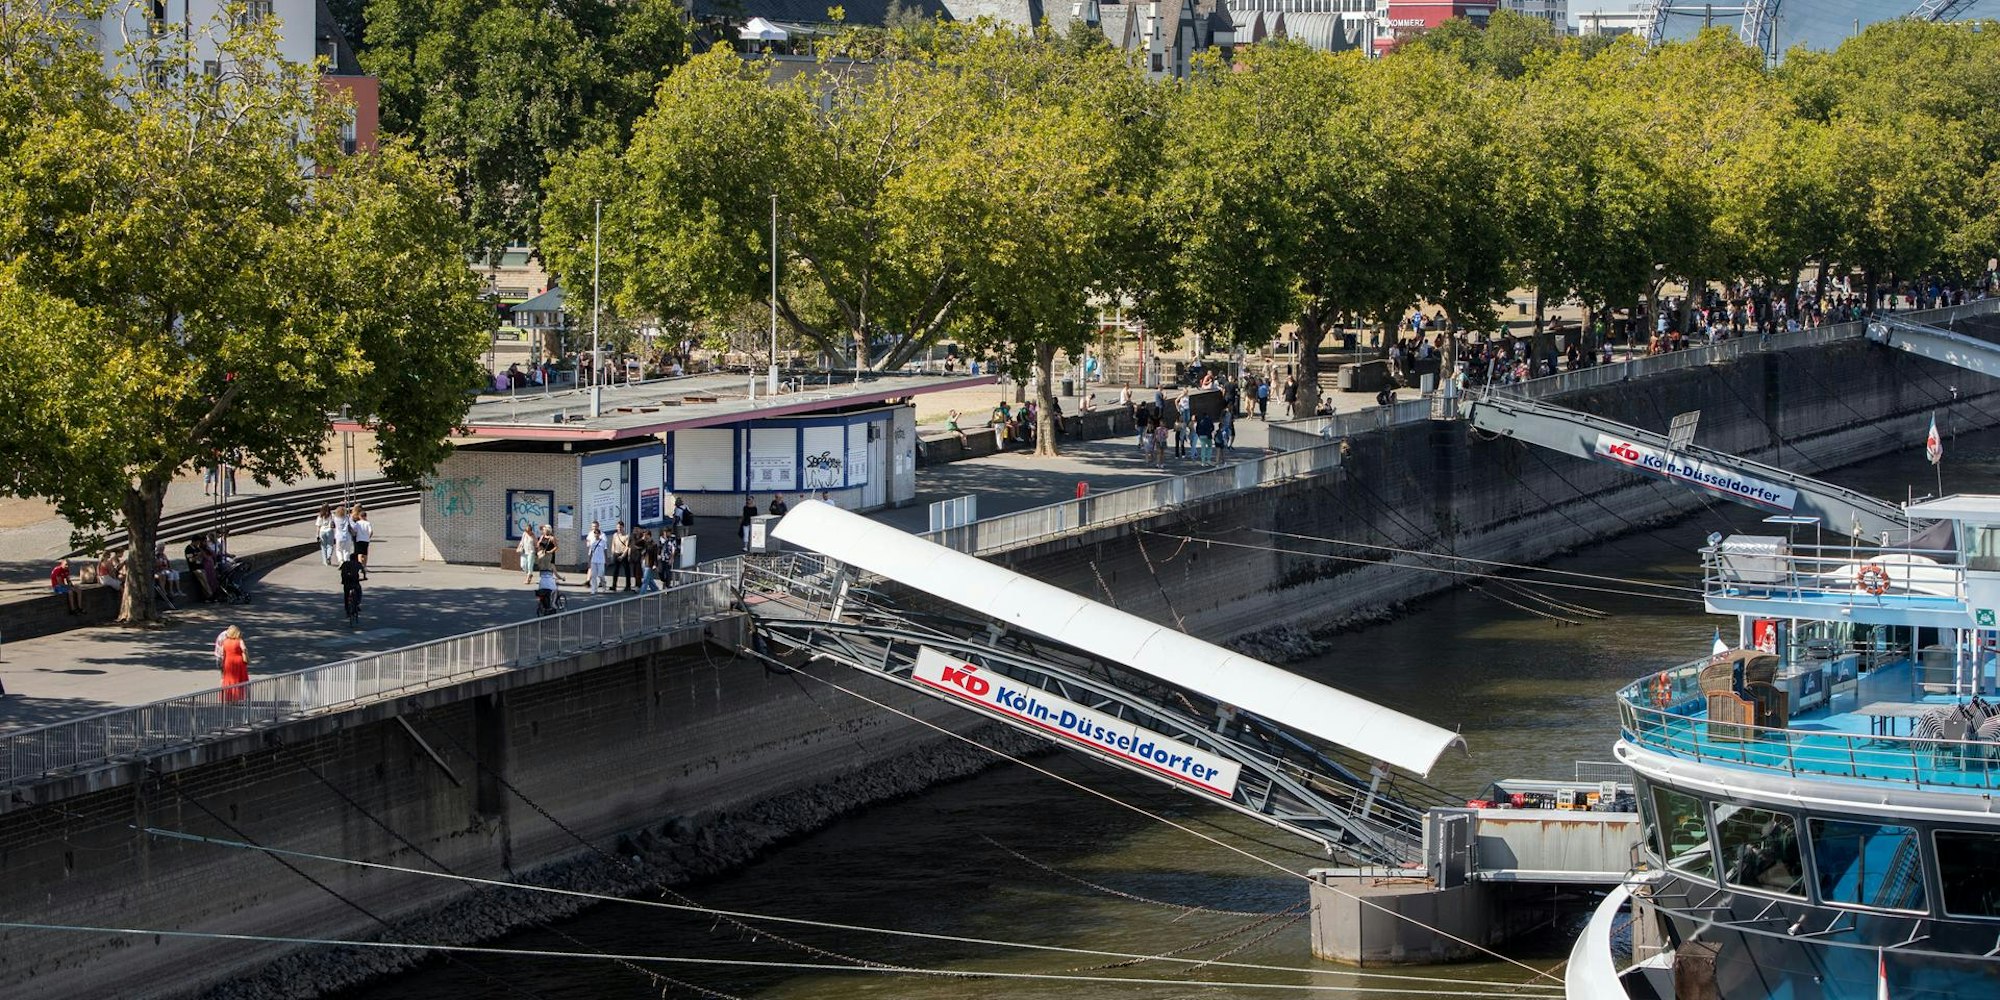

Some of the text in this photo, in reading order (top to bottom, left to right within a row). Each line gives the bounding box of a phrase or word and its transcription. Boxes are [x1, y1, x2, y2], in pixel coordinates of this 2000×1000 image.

[1609, 443, 1781, 502] KD Kön-Düsseldorfer
[941, 664, 1218, 783] KD Köln-Düsseldorfer
